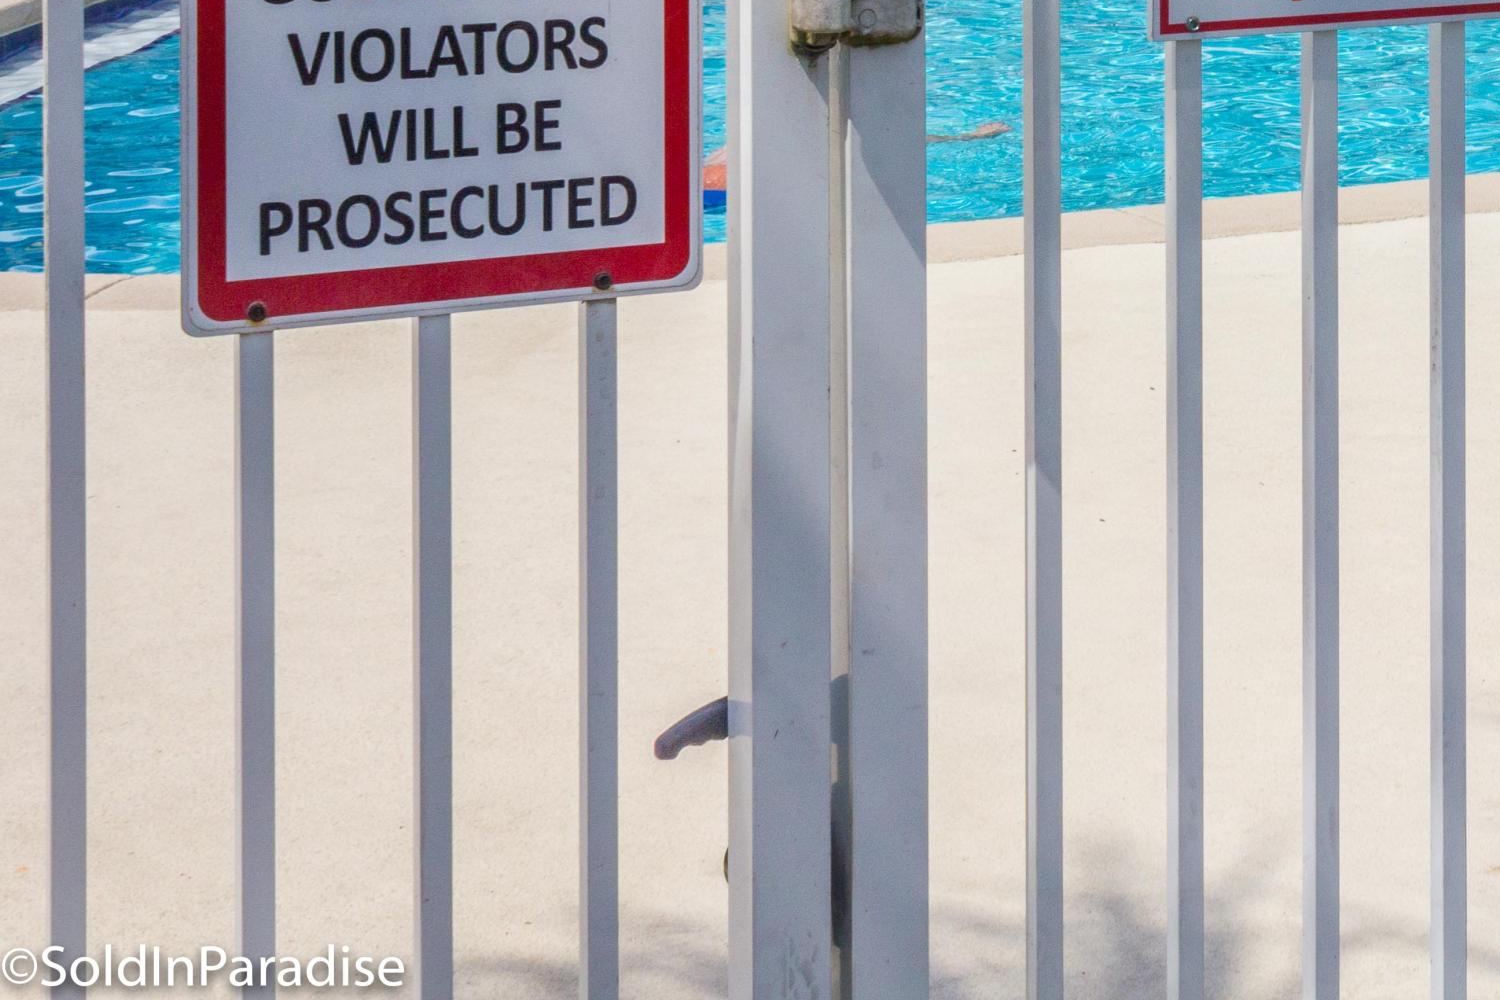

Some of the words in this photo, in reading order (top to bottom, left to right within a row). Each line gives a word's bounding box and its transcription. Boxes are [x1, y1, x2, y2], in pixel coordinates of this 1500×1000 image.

[287, 17, 608, 86] VIOLATORS
[337, 106, 479, 165] WILL
[496, 100, 562, 154] BE
[260, 176, 637, 255] PROSECUTED
